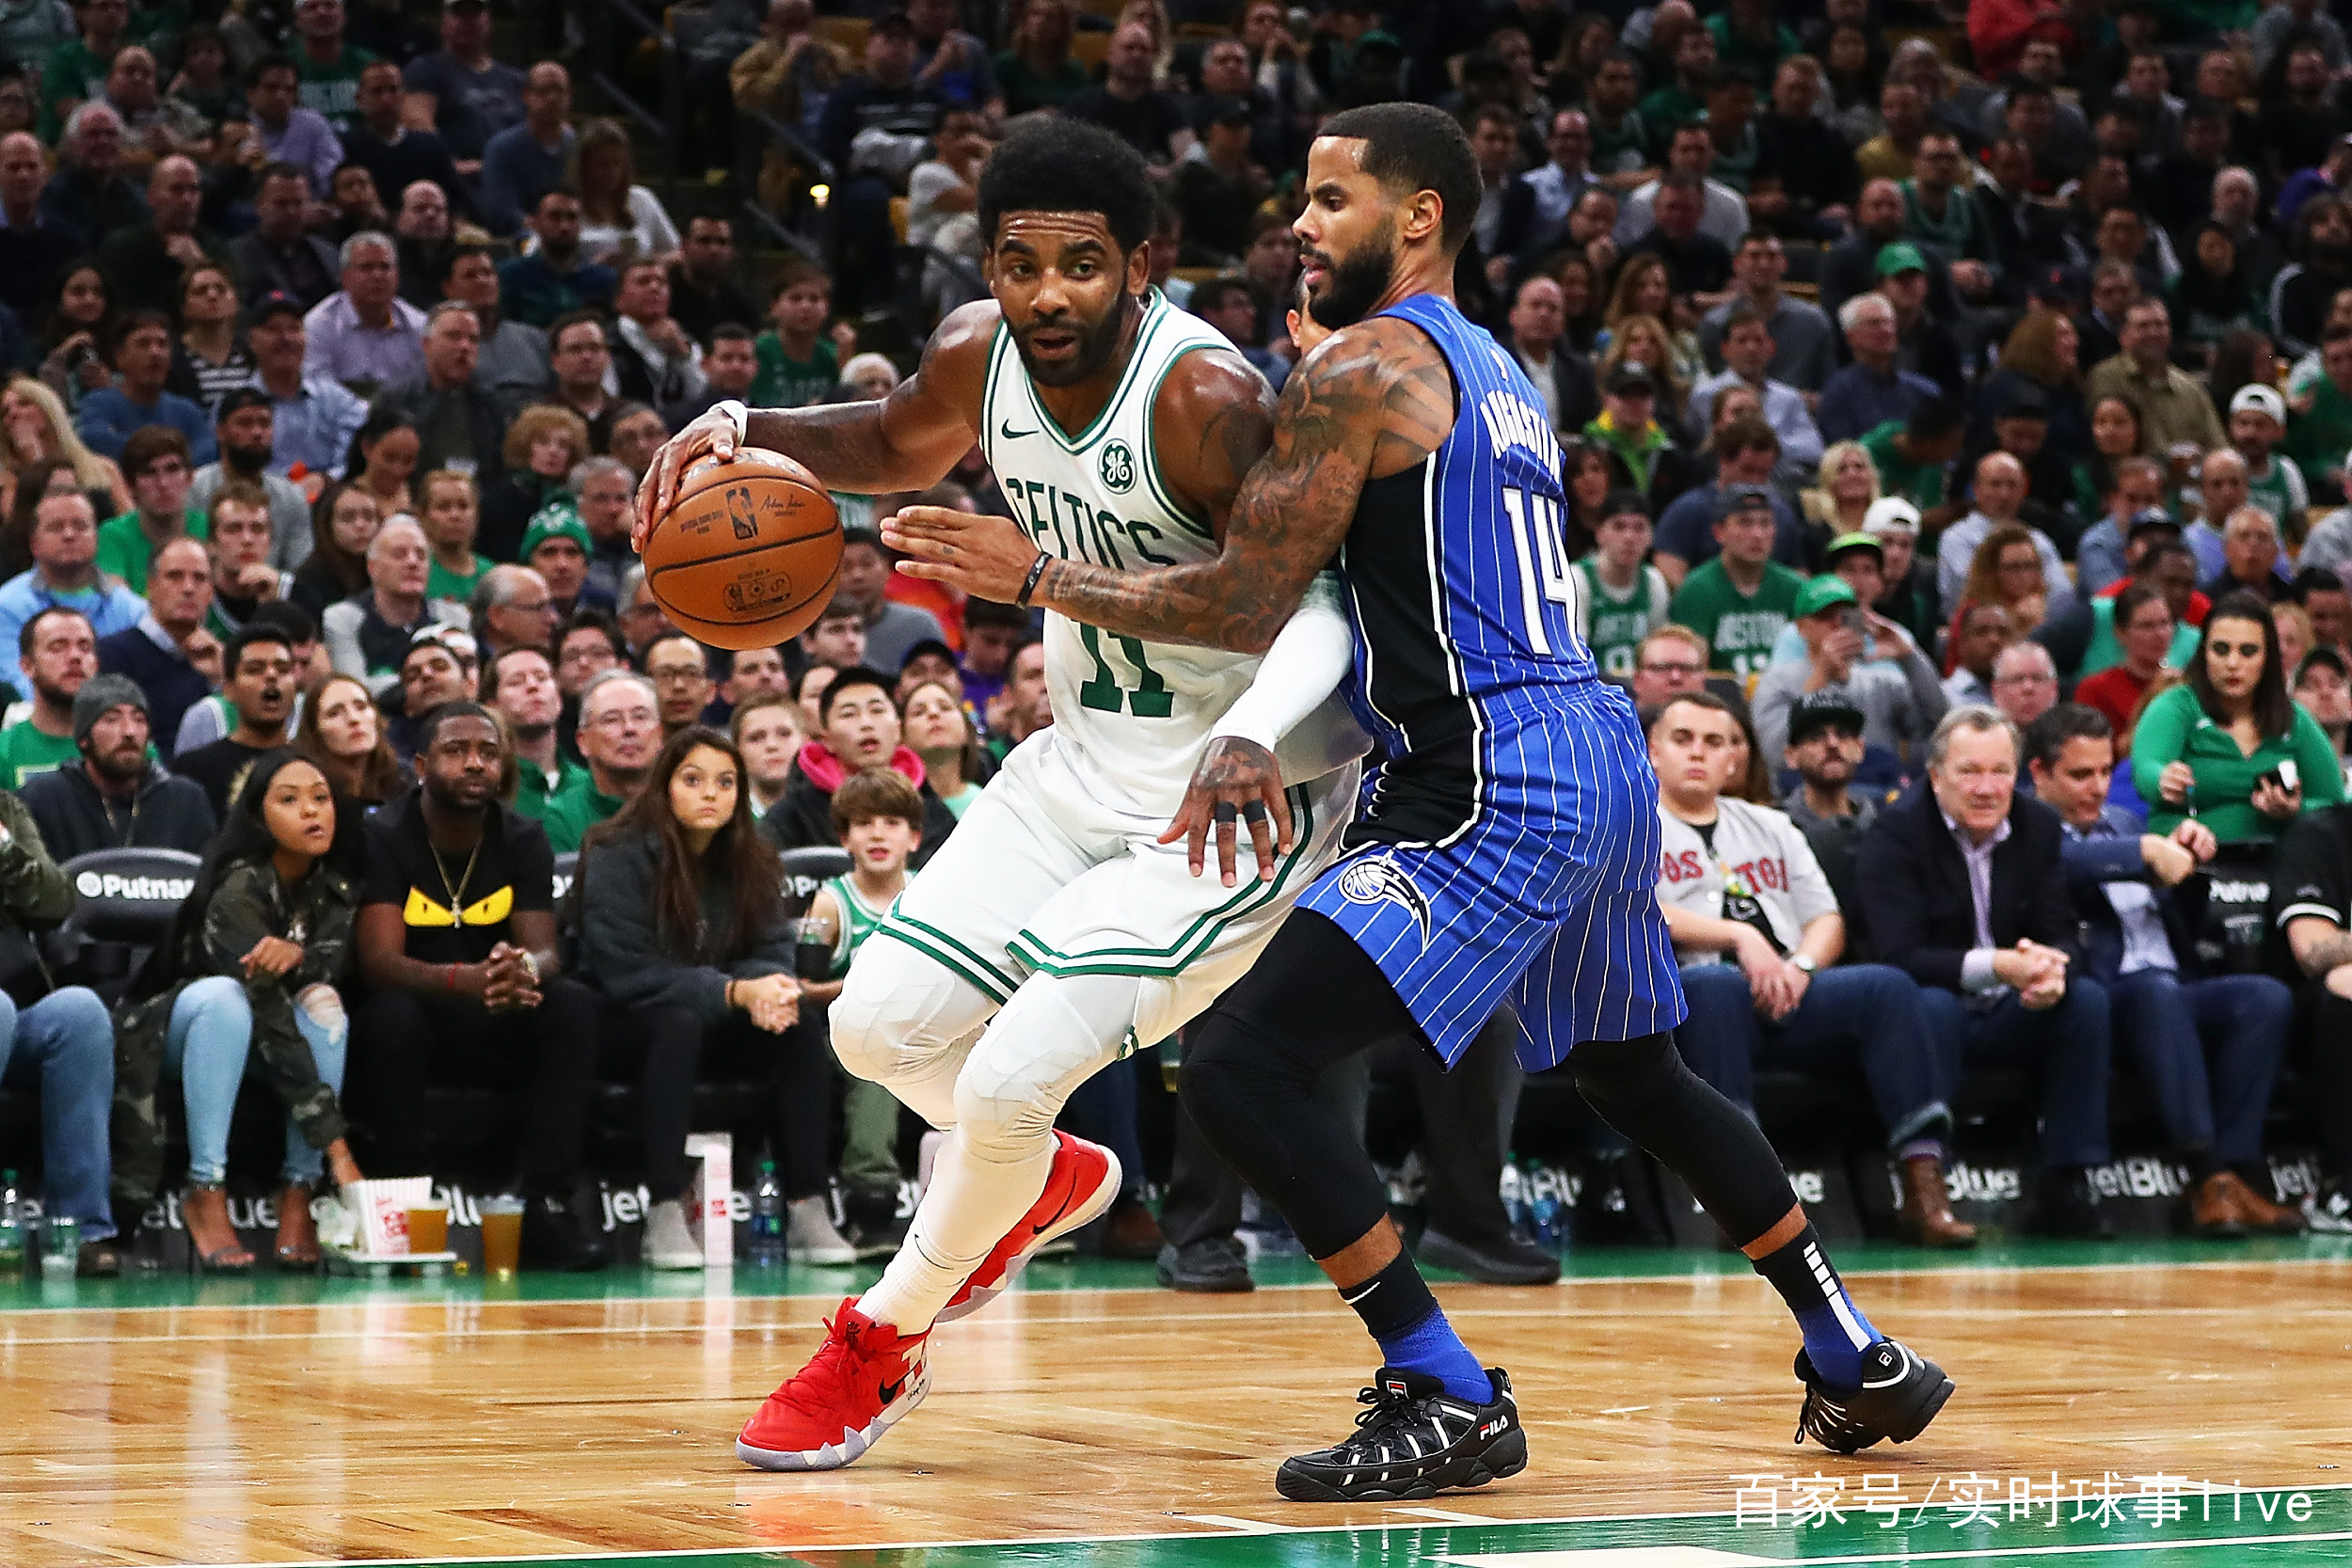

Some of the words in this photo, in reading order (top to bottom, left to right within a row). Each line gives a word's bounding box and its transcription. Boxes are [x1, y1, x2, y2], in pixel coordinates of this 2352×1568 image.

[1480, 389, 1561, 484] AUGUSTIN
[1502, 487, 1588, 661] 14
[1080, 621, 1174, 718] 11
[2084, 1155, 2190, 1205] jetBlu
[1480, 1415, 1508, 1440] FILA
